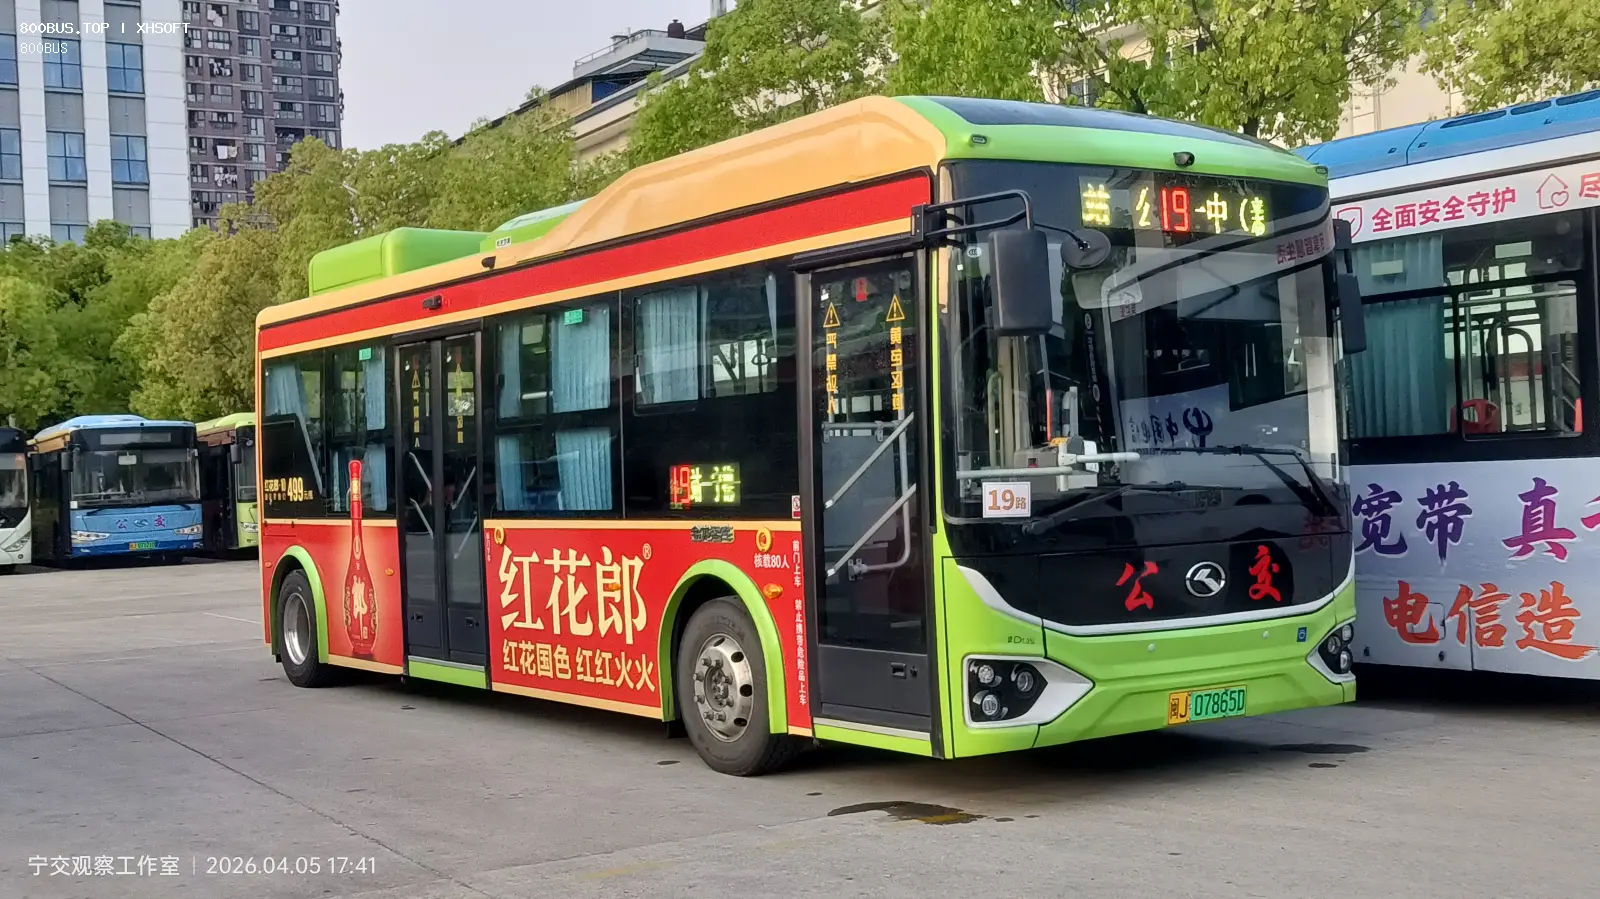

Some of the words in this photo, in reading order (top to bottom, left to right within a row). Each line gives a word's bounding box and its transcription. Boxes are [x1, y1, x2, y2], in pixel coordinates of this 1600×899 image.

[1371, 187, 1516, 232] 全面安全守护
[988, 489, 1027, 511] 19路
[1352, 481, 1472, 561] 宽带
[1502, 477, 1600, 561] 真
[753, 553, 790, 569] 核载80人
[792, 539, 802, 587] 前门上车
[1116, 561, 1159, 611] 公
[1248, 544, 1282, 602] 交
[1383, 580, 1600, 660] 电信造
[502, 638, 572, 680] 红花国色
[575, 646, 656, 693] 红红火火
[1194, 689, 1246, 717] 07865D
